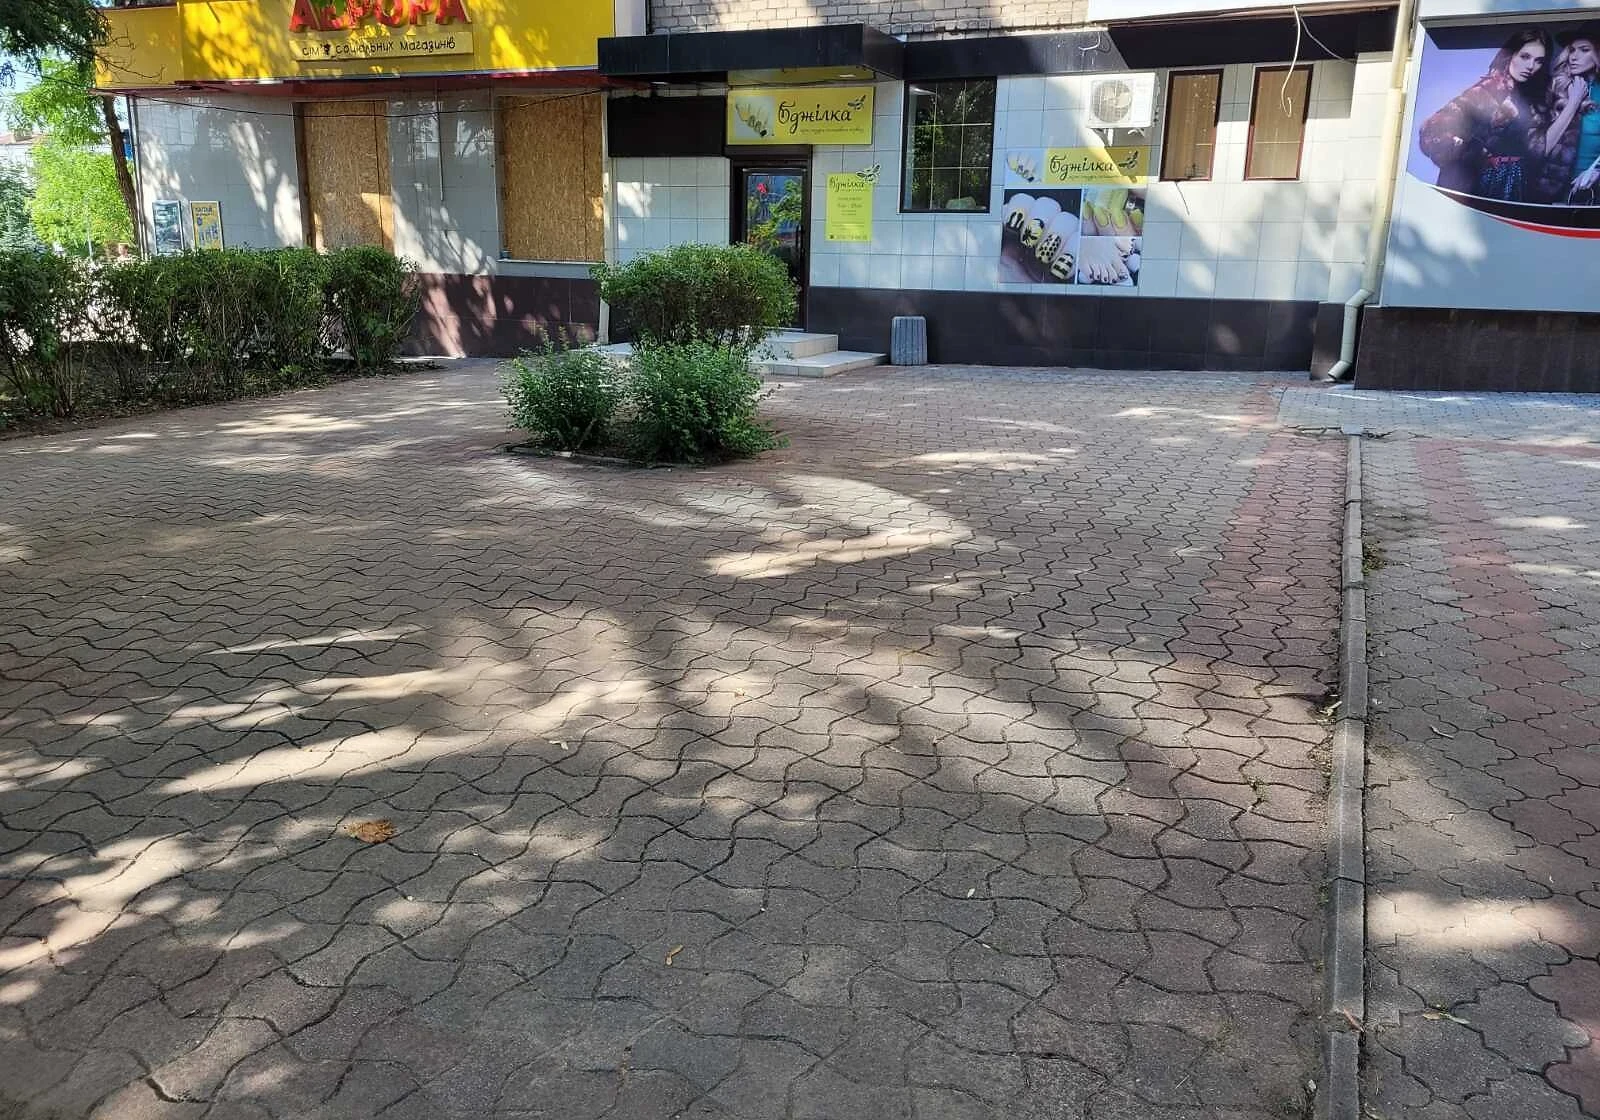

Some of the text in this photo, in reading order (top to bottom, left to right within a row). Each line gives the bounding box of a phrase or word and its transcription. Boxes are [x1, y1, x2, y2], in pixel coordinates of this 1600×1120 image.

[335, 41, 394, 55] соціальних
[400, 36, 455, 52] магазинів
[778, 100, 852, 134] Бджілка
[1049, 155, 1114, 181] Бджілка
